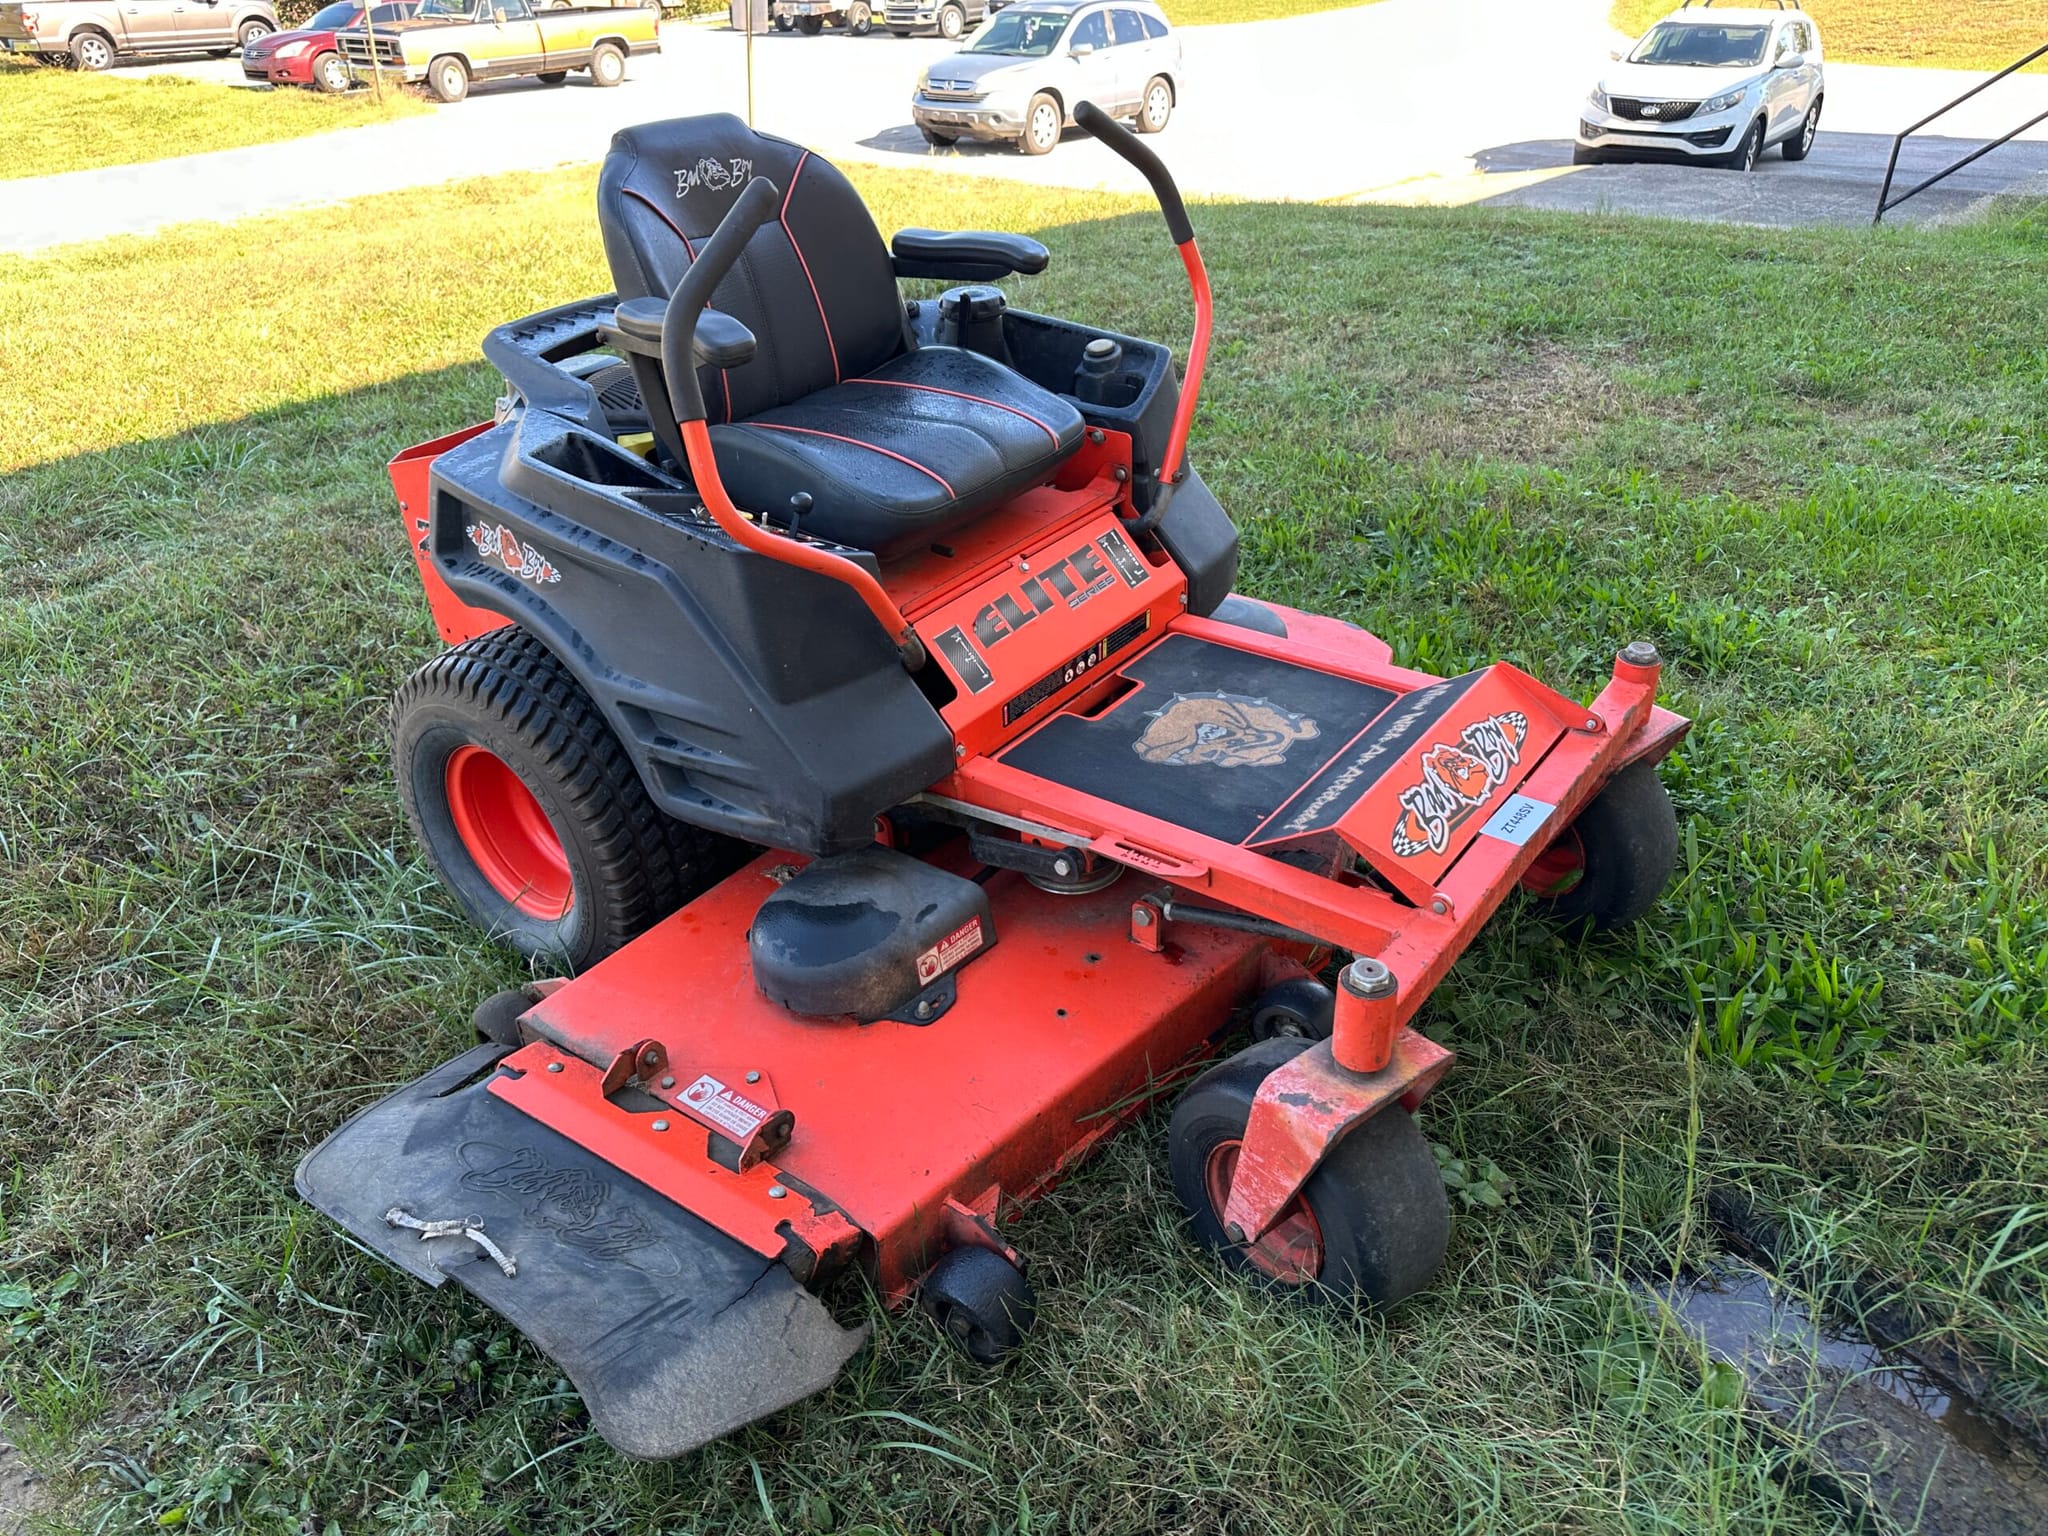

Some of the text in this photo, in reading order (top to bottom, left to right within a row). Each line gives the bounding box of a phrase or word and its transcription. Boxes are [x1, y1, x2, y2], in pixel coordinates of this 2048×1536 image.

[973, 543, 1108, 648] ELITE
[1068, 573, 1116, 609] SERIES
[1398, 713, 1521, 857] Bad Boy
[1500, 802, 1534, 834] ZT448SV
[949, 918, 979, 945] DANGER
[731, 1095, 768, 1120] DANGER
